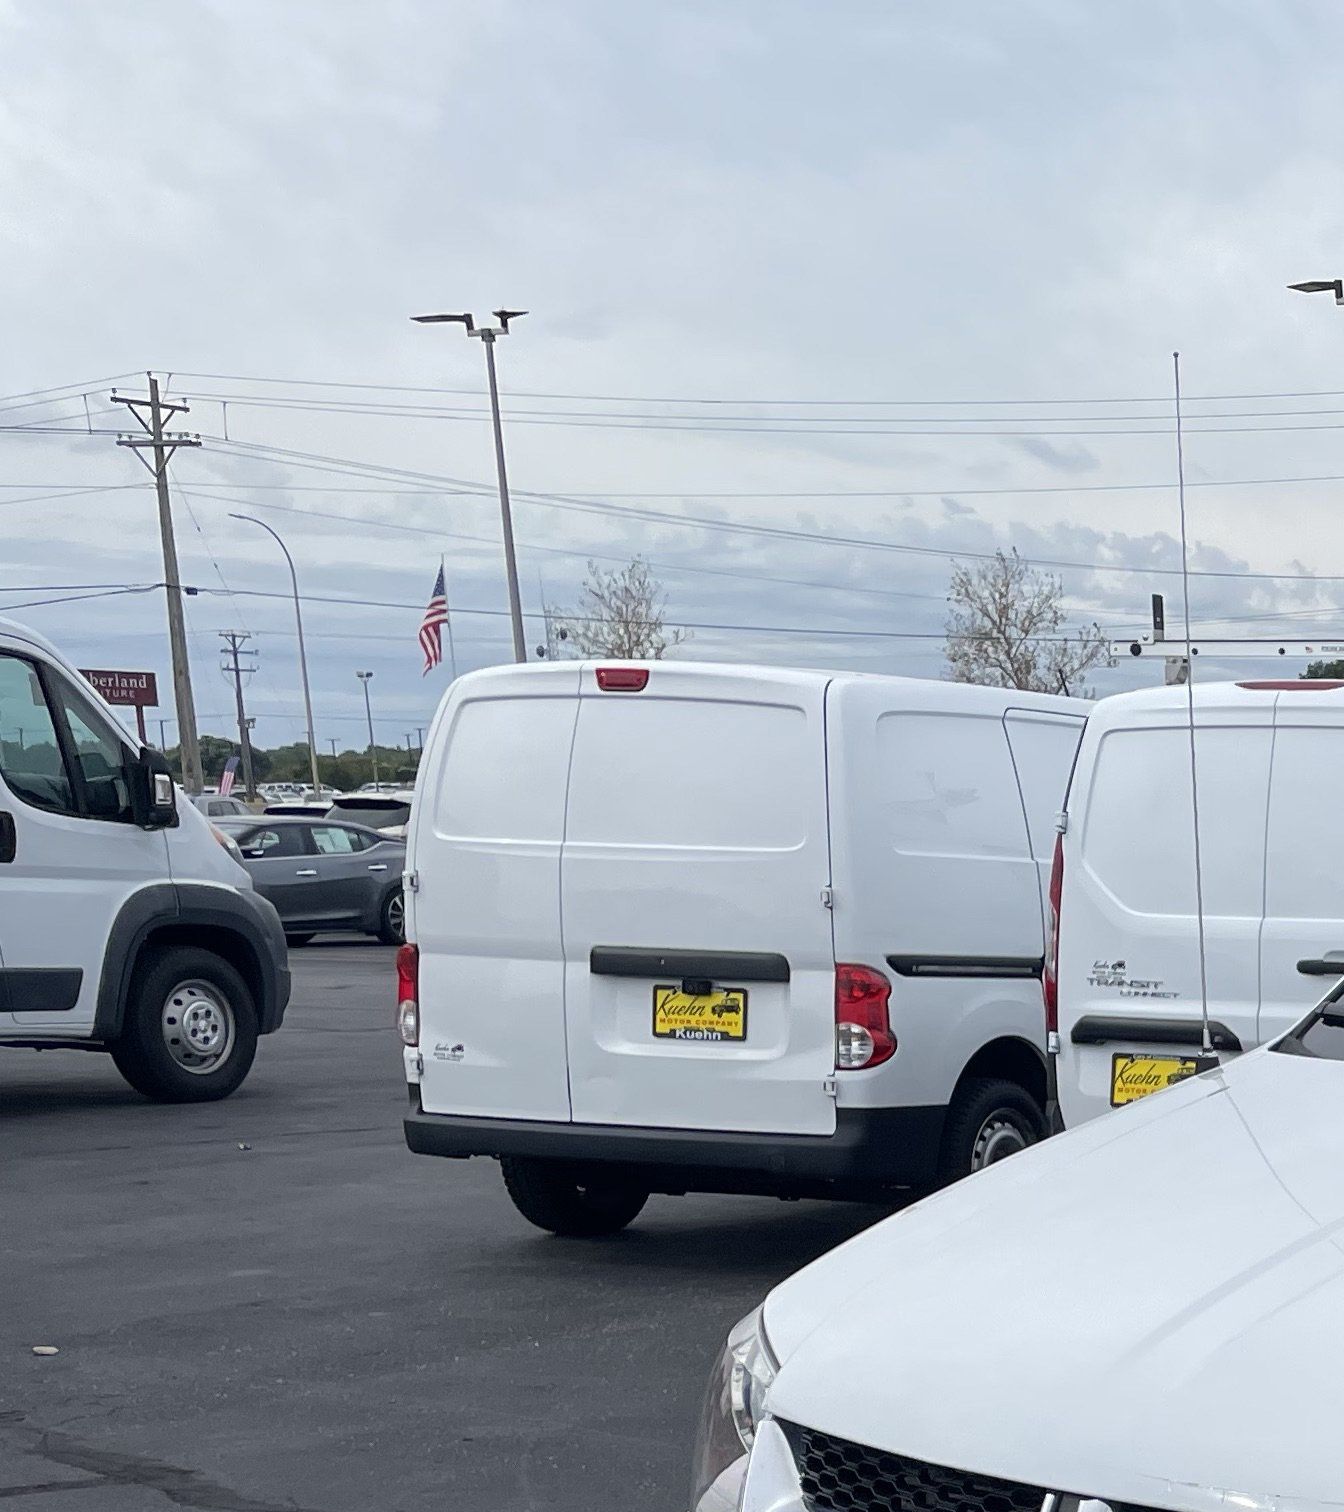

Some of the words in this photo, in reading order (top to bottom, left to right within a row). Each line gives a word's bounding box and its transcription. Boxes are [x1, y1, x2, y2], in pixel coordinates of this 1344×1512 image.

[89, 672, 147, 689] berland
[656, 992, 706, 1018] Kuehn
[659, 1018, 692, 1026] MOTOR
[696, 1020, 739, 1028] COMPANY
[675, 1027, 721, 1041] Kuehn
[1114, 1061, 1161, 1087] Kuehn
